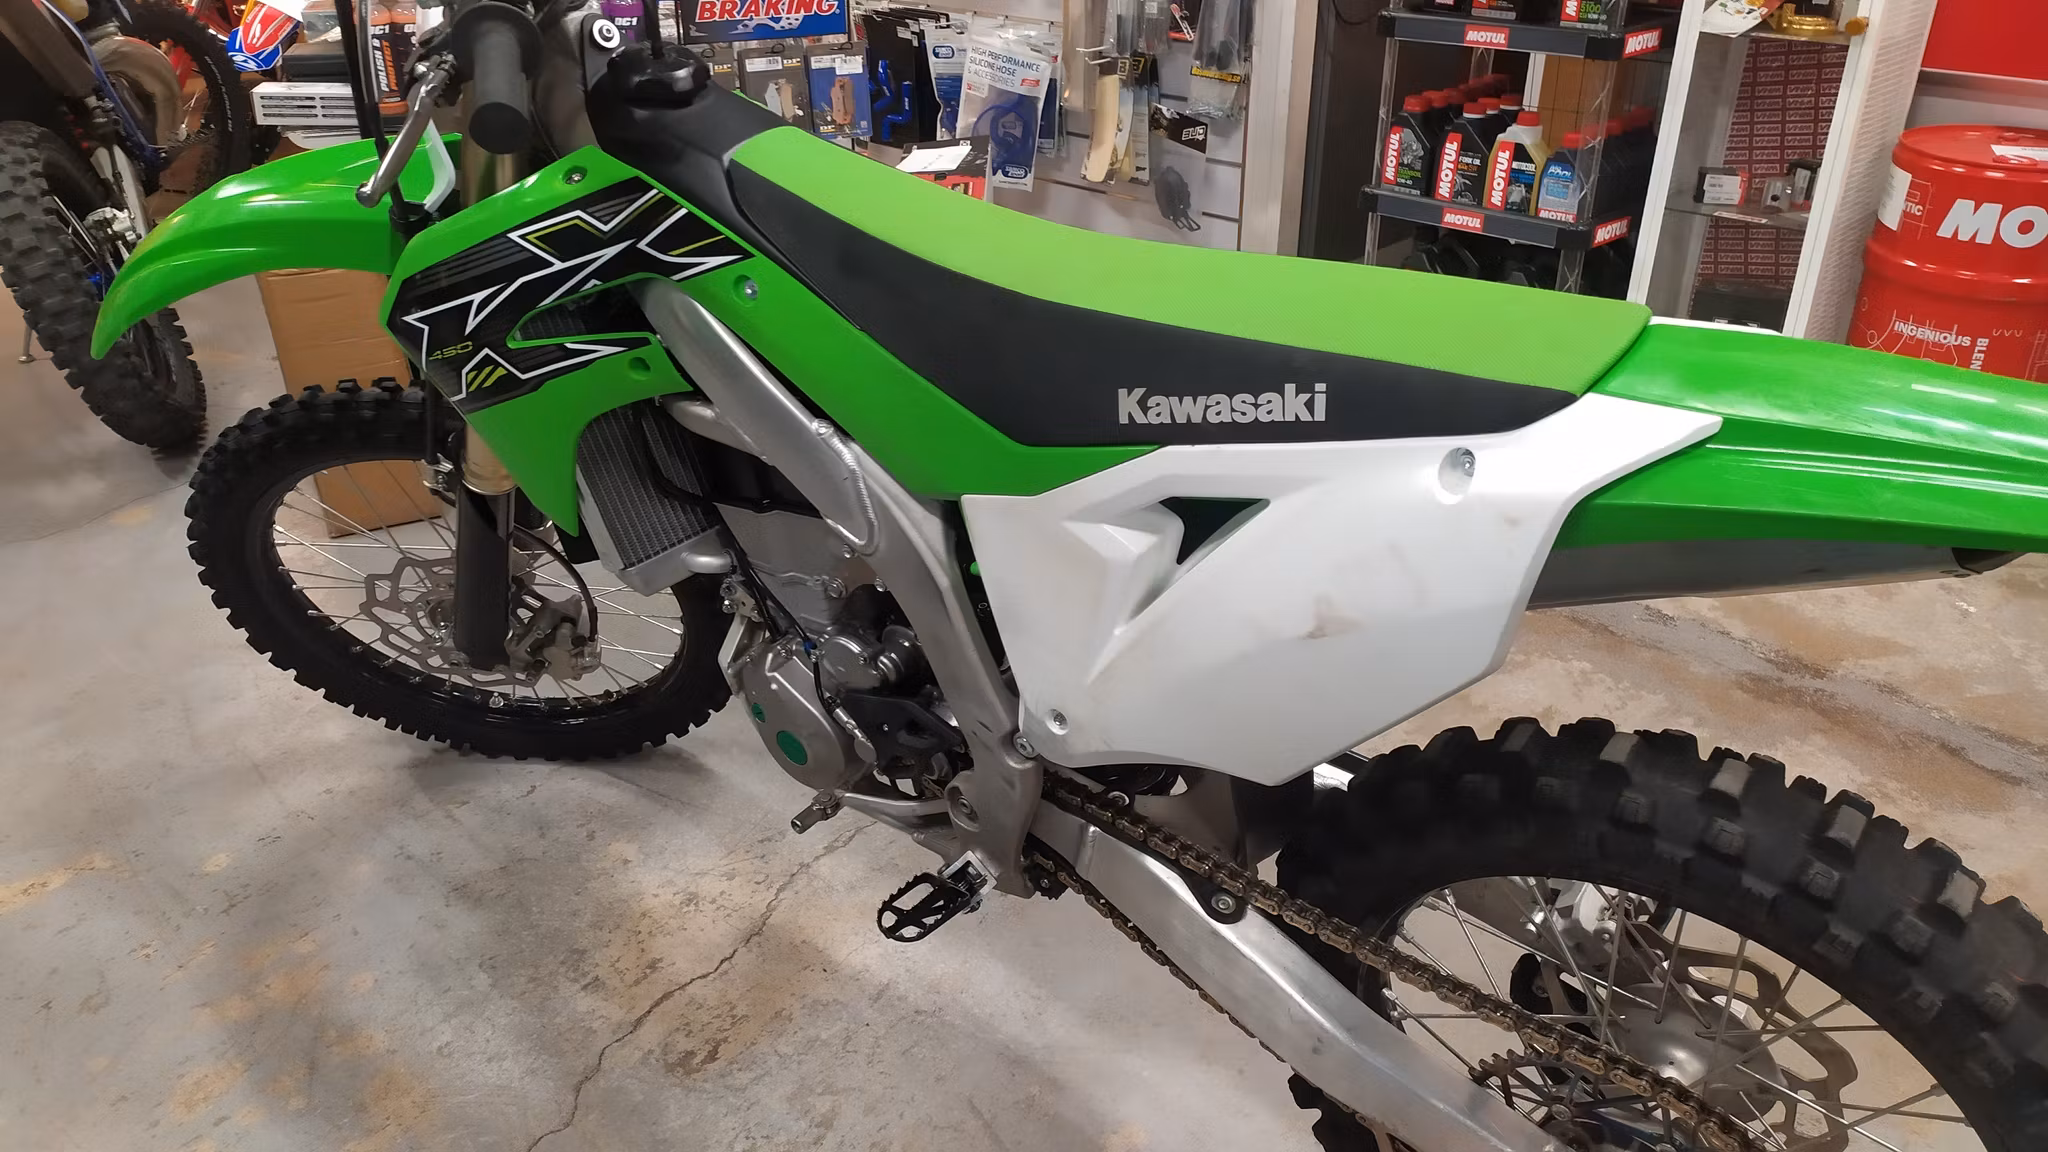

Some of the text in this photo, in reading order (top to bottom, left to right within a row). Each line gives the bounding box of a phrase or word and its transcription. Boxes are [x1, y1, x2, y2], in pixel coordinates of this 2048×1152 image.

[695, 0, 837, 22] BRAKING
[1466, 31, 1505, 44] MOTUL
[1625, 31, 1659, 54] MOTUL
[373, 50, 389, 92] POLISH
[969, 56, 1018, 77] SILICONE HOSE
[971, 46, 986, 57] HIGH
[987, 50, 1041, 73] PERFORMANCE
[973, 69, 1015, 88] ACCESSORIES
[1385, 133, 1400, 181] MOTUL
[1438, 141, 1458, 198] MOTUL
[1490, 150, 1510, 207] MOTUL
[1444, 213, 1481, 228] MOTUL
[1539, 209, 1575, 223] MOTUL
[1595, 219, 1628, 243] MOTUL
[1894, 320, 1972, 347] INGENIOUS
[428, 341, 473, 360] 450
[1118, 383, 1327, 424] Kawasaki
